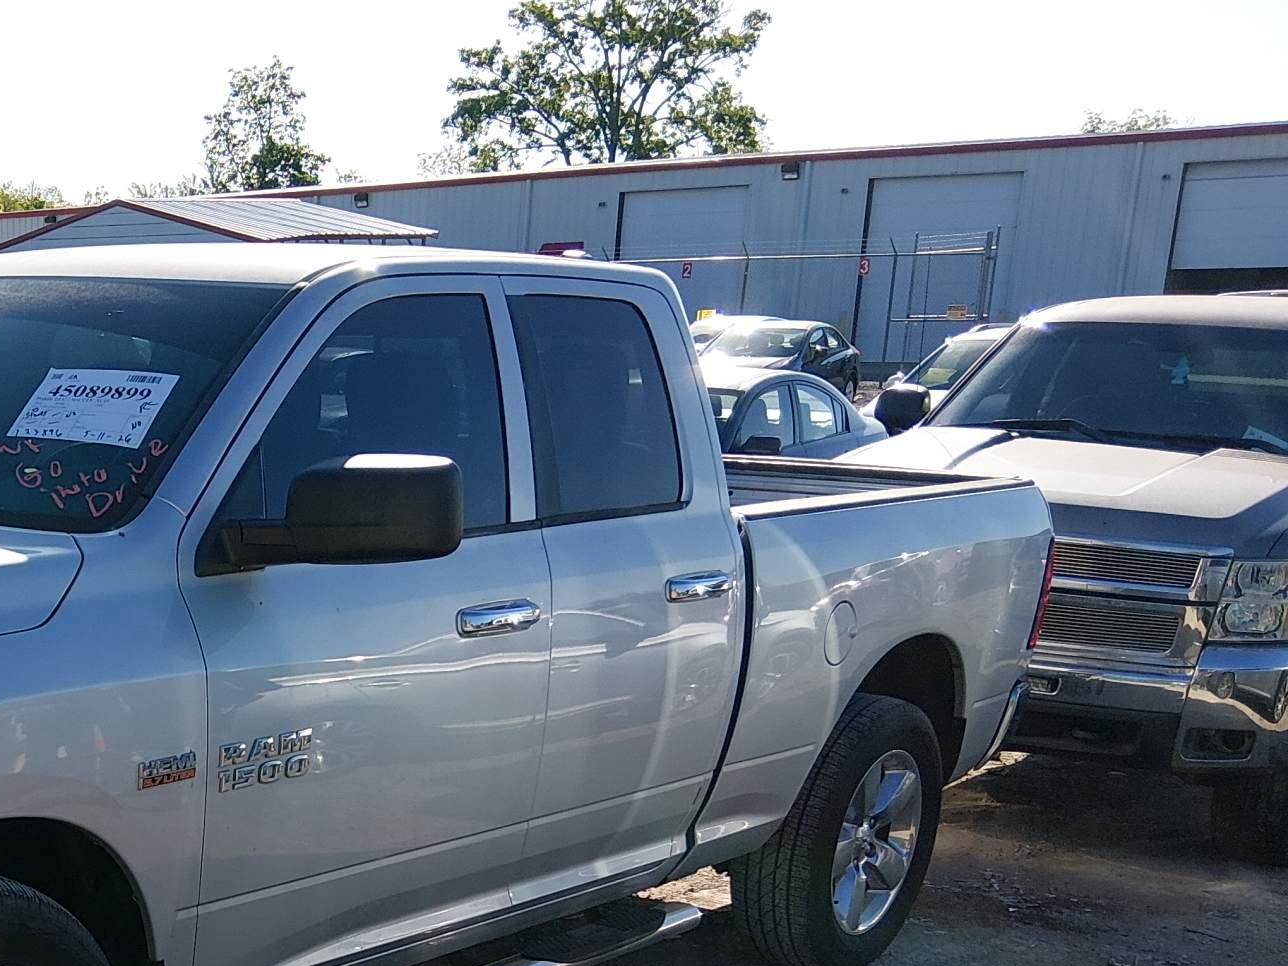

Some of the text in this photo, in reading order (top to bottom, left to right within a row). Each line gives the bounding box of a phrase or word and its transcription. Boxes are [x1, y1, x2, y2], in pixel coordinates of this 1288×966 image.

[683, 264, 691, 277] 2
[860, 259, 869, 274] 3
[48, 384, 152, 401] 45089899
[219, 728, 312, 768] RAM
[138, 751, 196, 780] HEMI
[217, 754, 310, 793] 1500
